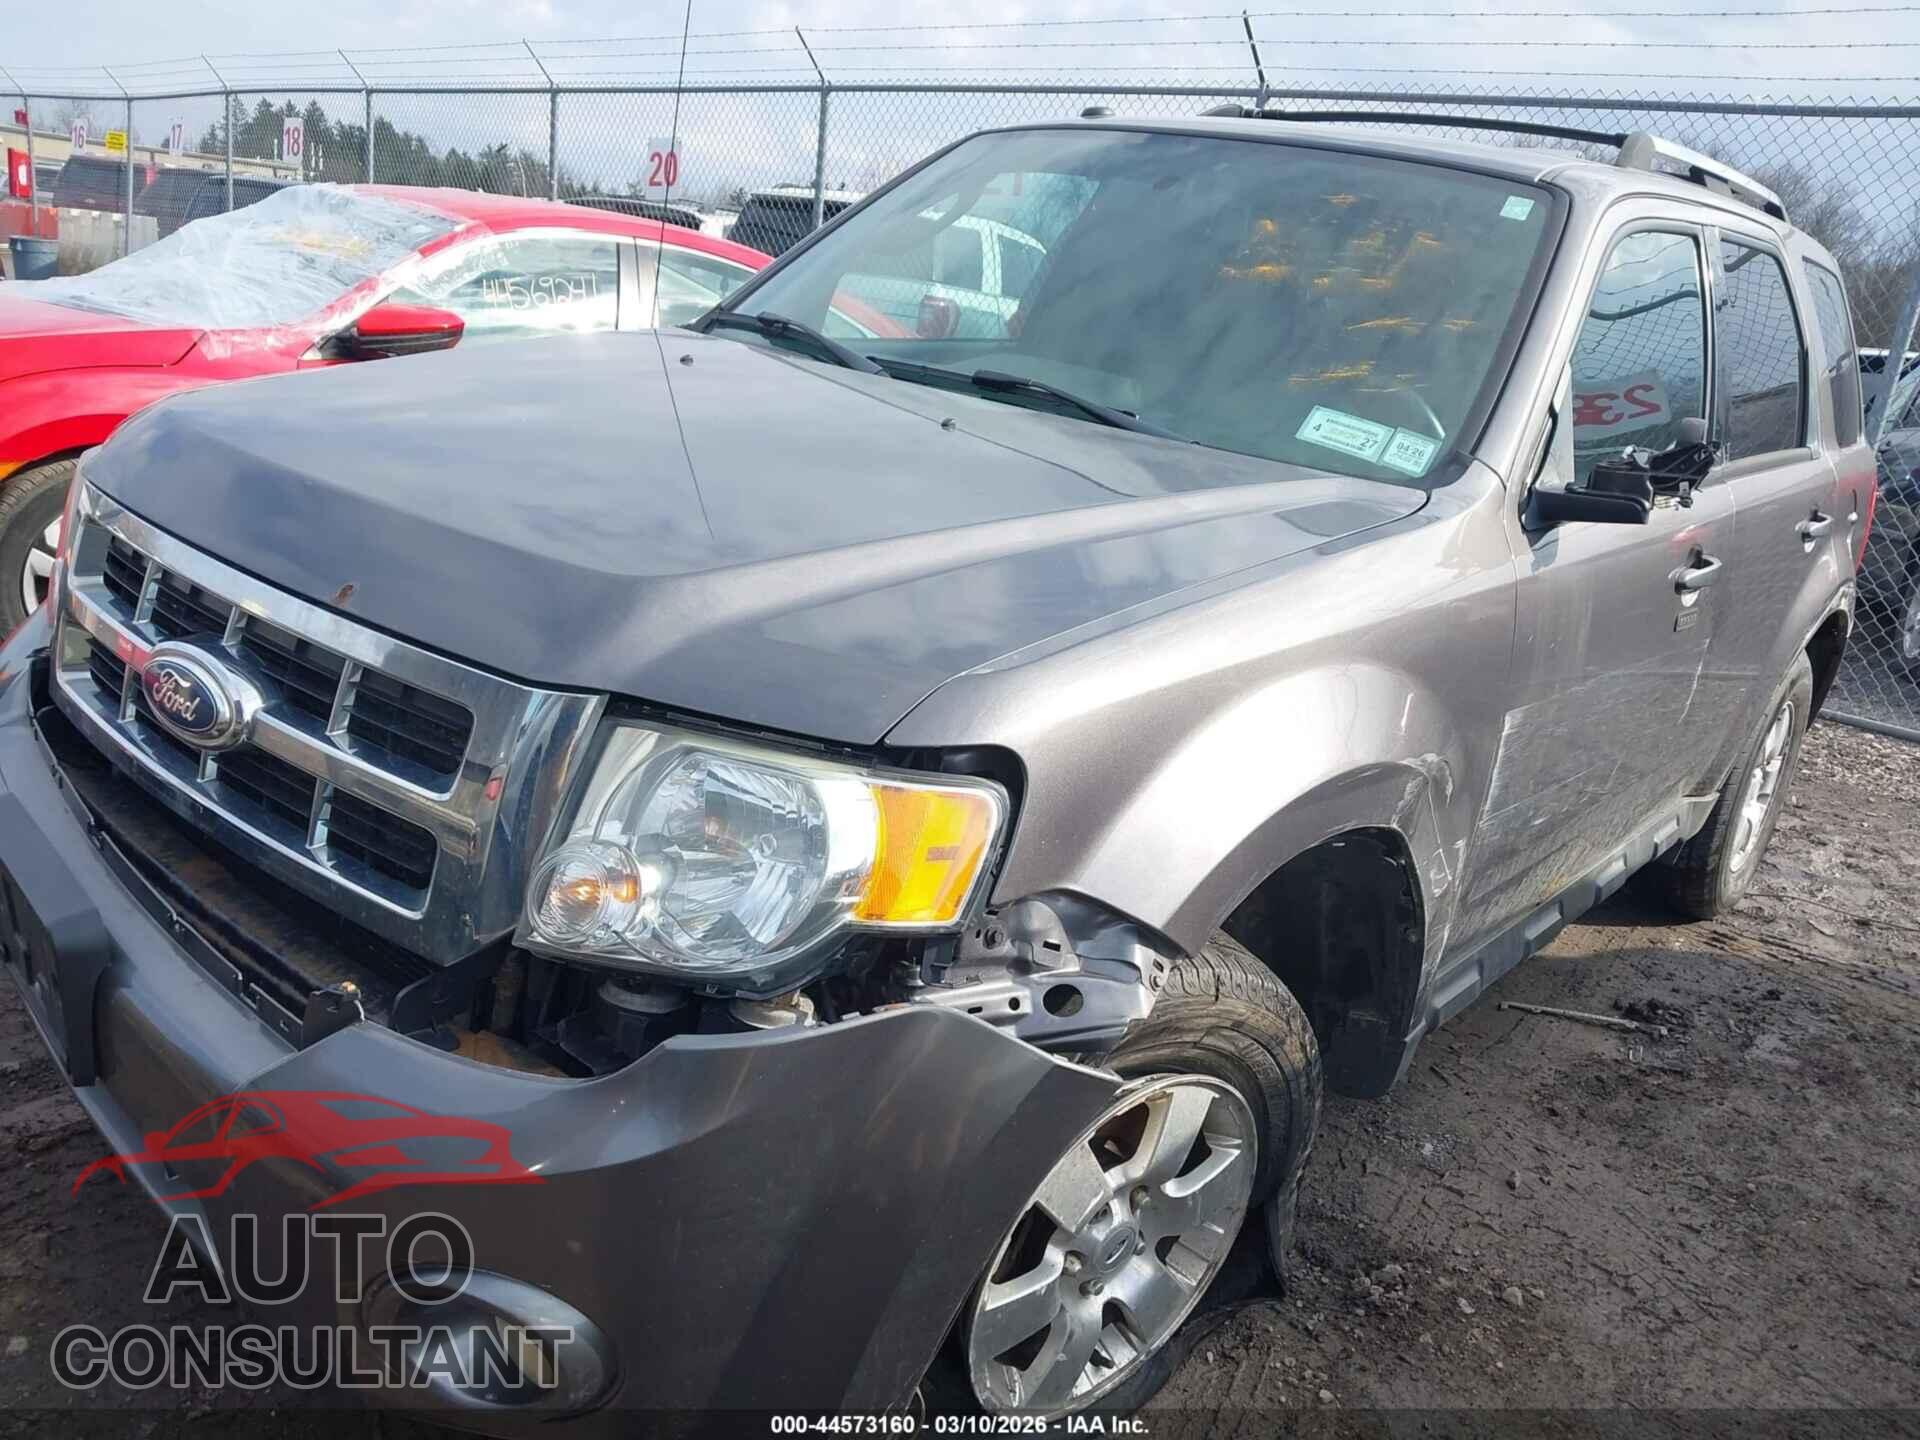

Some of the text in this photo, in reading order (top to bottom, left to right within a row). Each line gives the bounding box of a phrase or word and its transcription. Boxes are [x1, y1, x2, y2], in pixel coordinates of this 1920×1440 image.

[73, 125, 85, 148] 16
[170, 126, 183, 149] 17
[284, 127, 301, 156] 18
[648, 151, 678, 187] 20
[1360, 438, 1379, 449] 27
[152, 668, 201, 721] Ford
